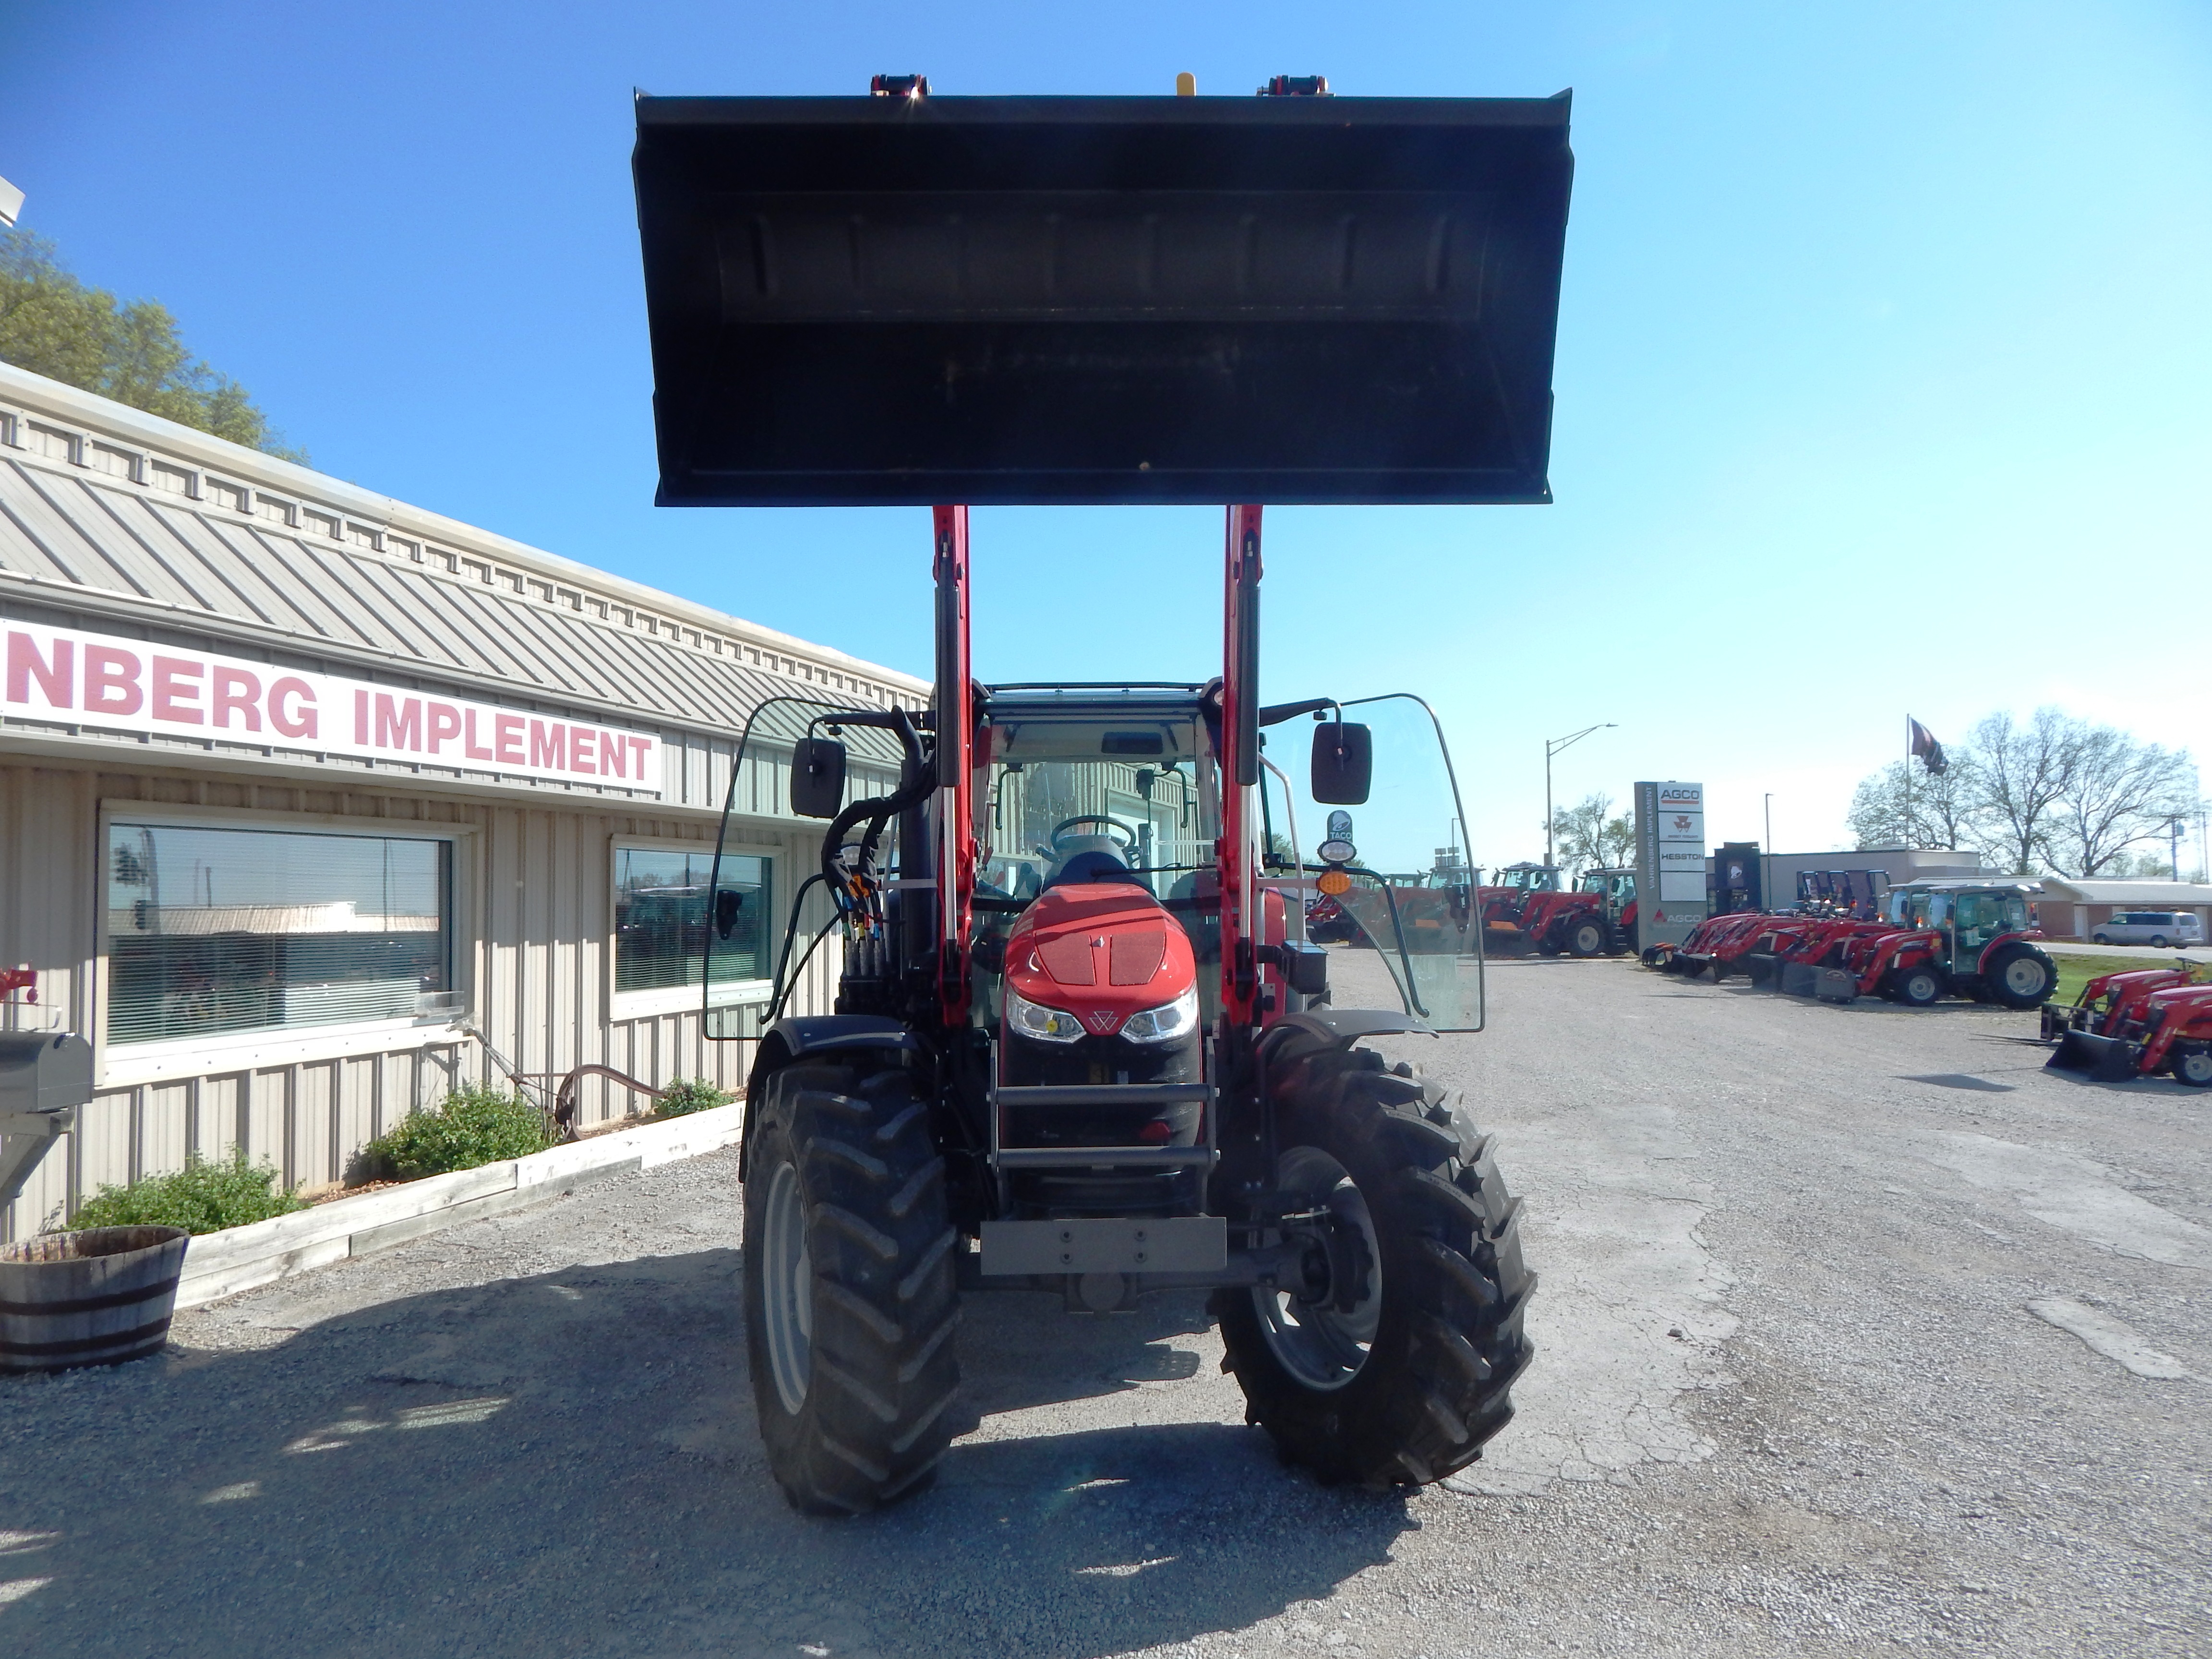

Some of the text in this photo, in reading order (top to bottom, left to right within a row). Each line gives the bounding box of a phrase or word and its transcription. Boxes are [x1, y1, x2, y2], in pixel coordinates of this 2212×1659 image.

[7, 631, 651, 781] NBERG IMPLEMENT
[1660, 789, 1699, 800] AGCO
